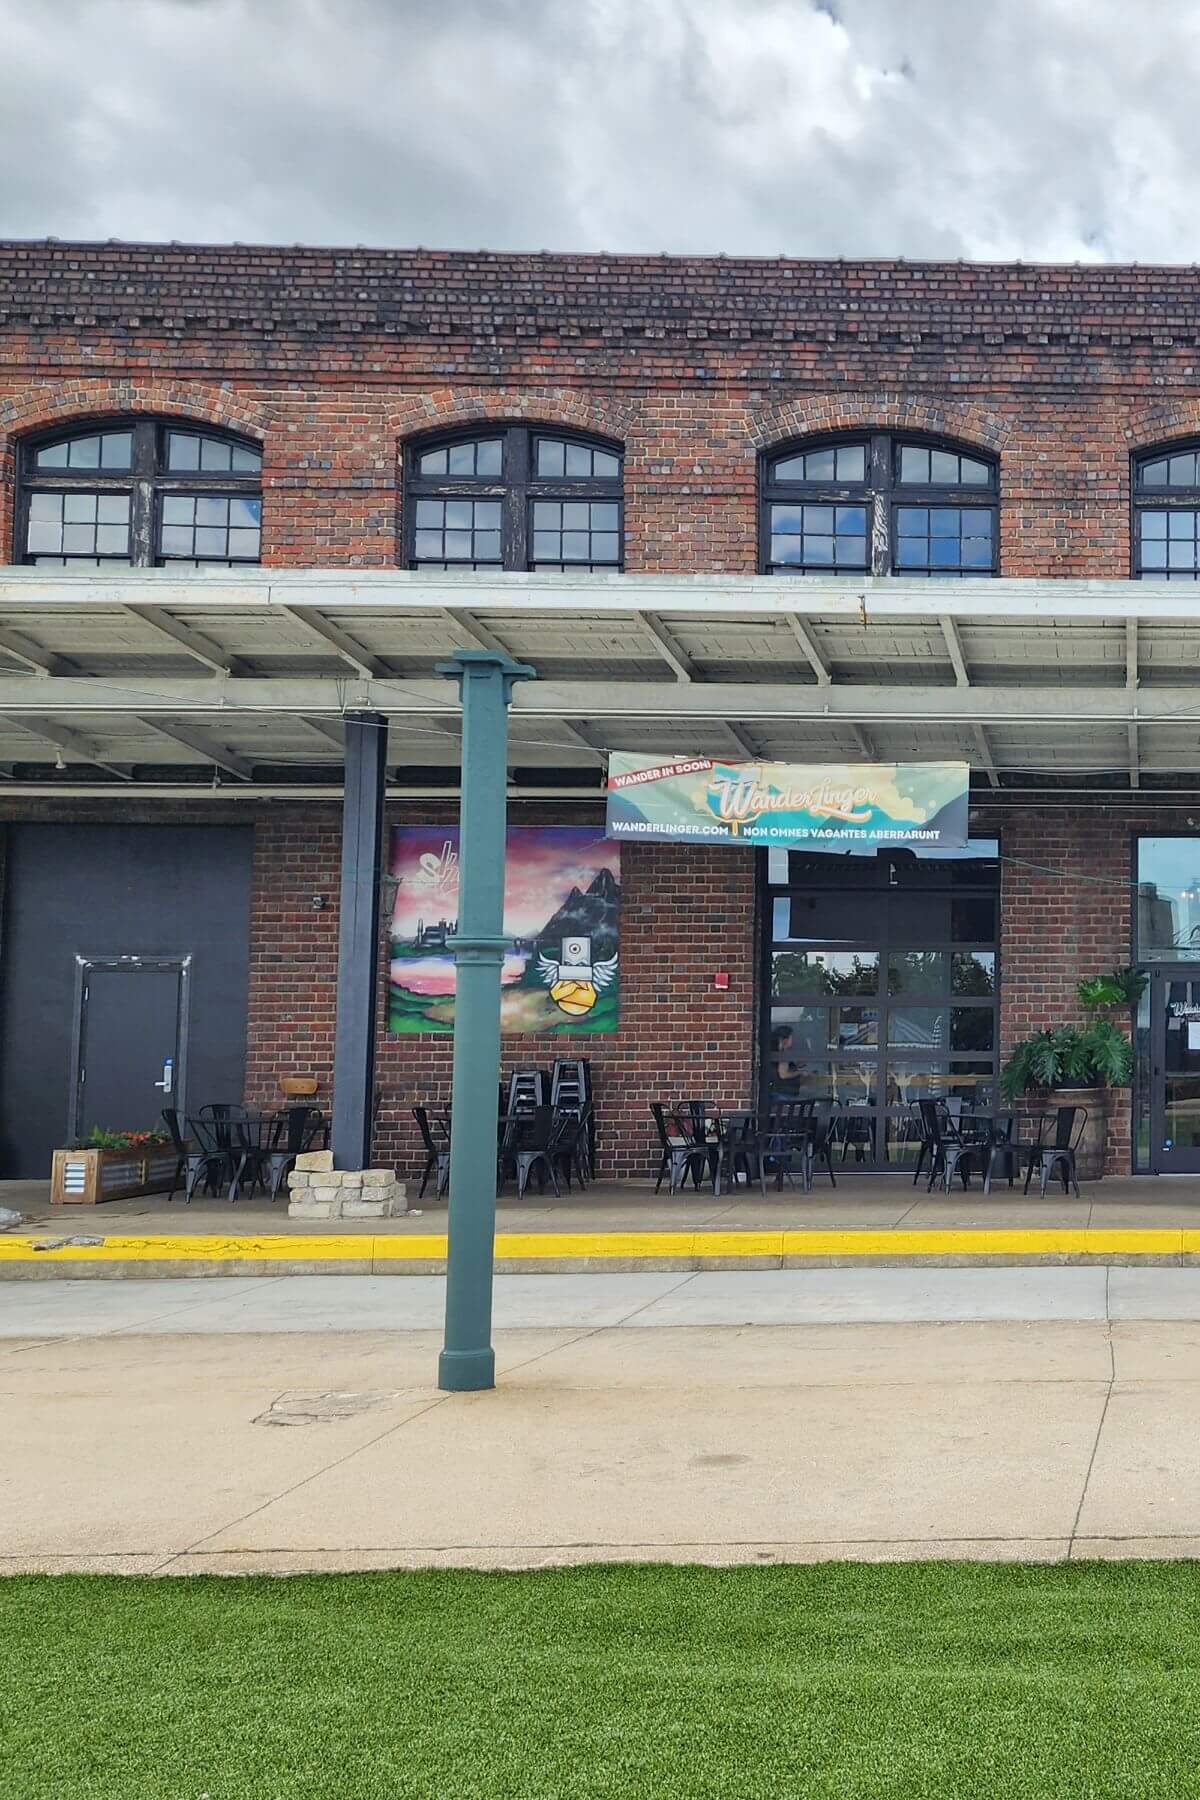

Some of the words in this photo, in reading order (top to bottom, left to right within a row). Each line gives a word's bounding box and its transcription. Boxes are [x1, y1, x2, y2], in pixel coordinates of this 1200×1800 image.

[614, 769, 660, 787] WANDER
[662, 766, 674, 778] IN
[675, 760, 711, 774] SOON!
[612, 822, 728, 836] WANDERLINGER.COM
[743, 827, 768, 837] NON
[770, 828, 808, 838] OMNES
[811, 828, 867, 839] VAGANTES
[869, 830, 940, 840] ABERRARUNT
